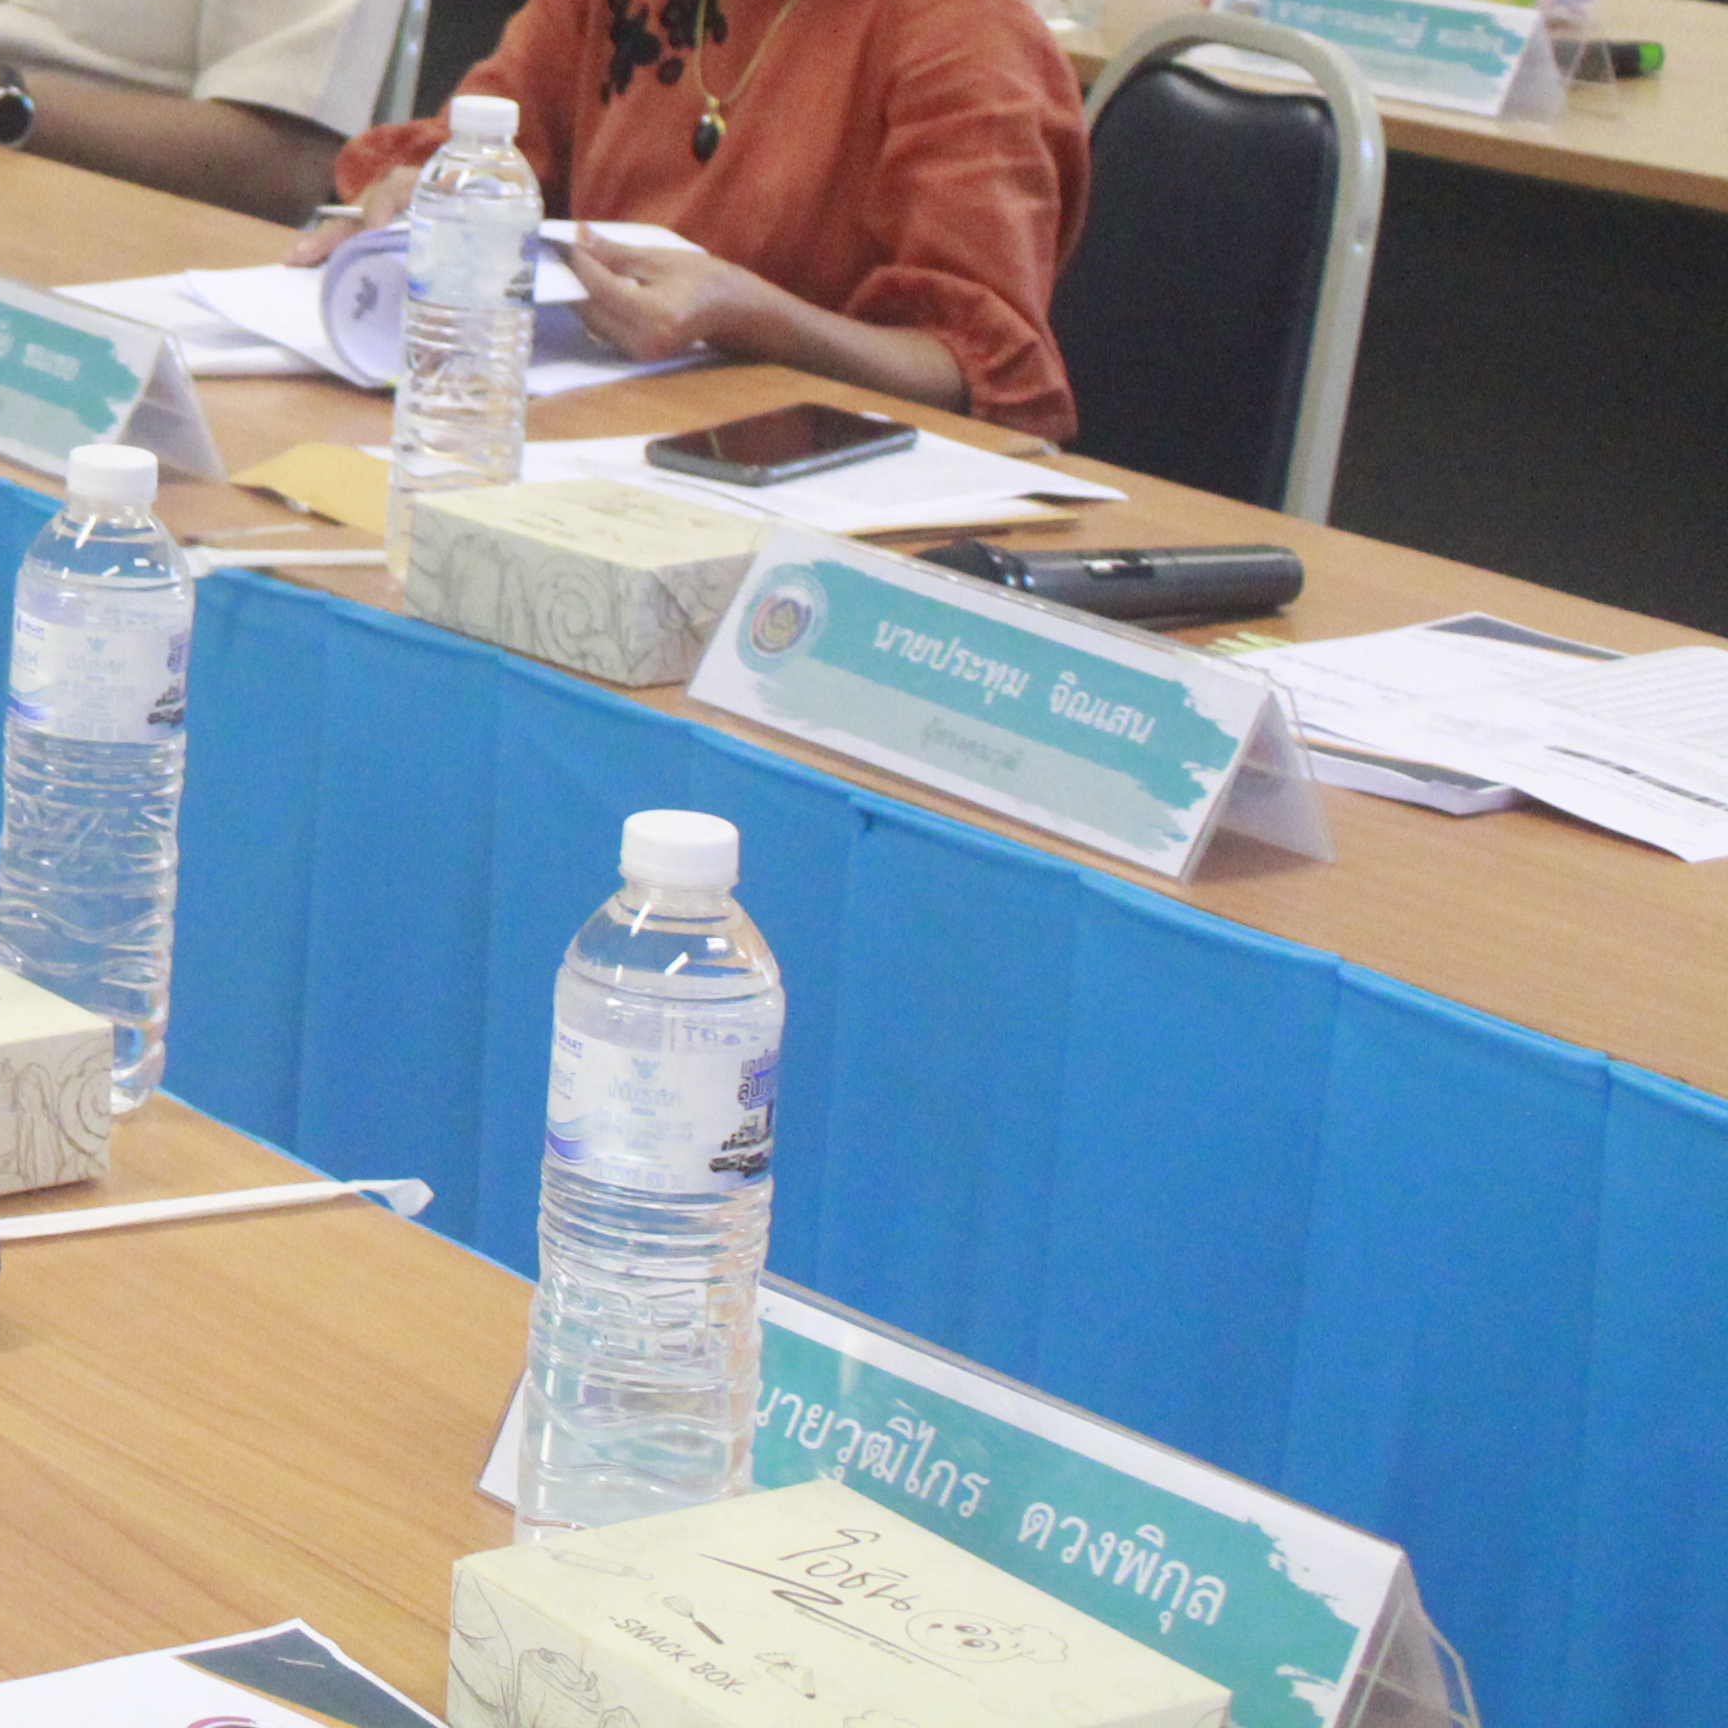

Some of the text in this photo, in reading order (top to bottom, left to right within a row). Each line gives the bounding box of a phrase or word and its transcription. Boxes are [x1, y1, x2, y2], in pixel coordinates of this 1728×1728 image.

[873, 620, 1030, 705] นายประทุม
[754, 1378, 1228, 1634] นายวุฒิไกร ดวงพิกุล
